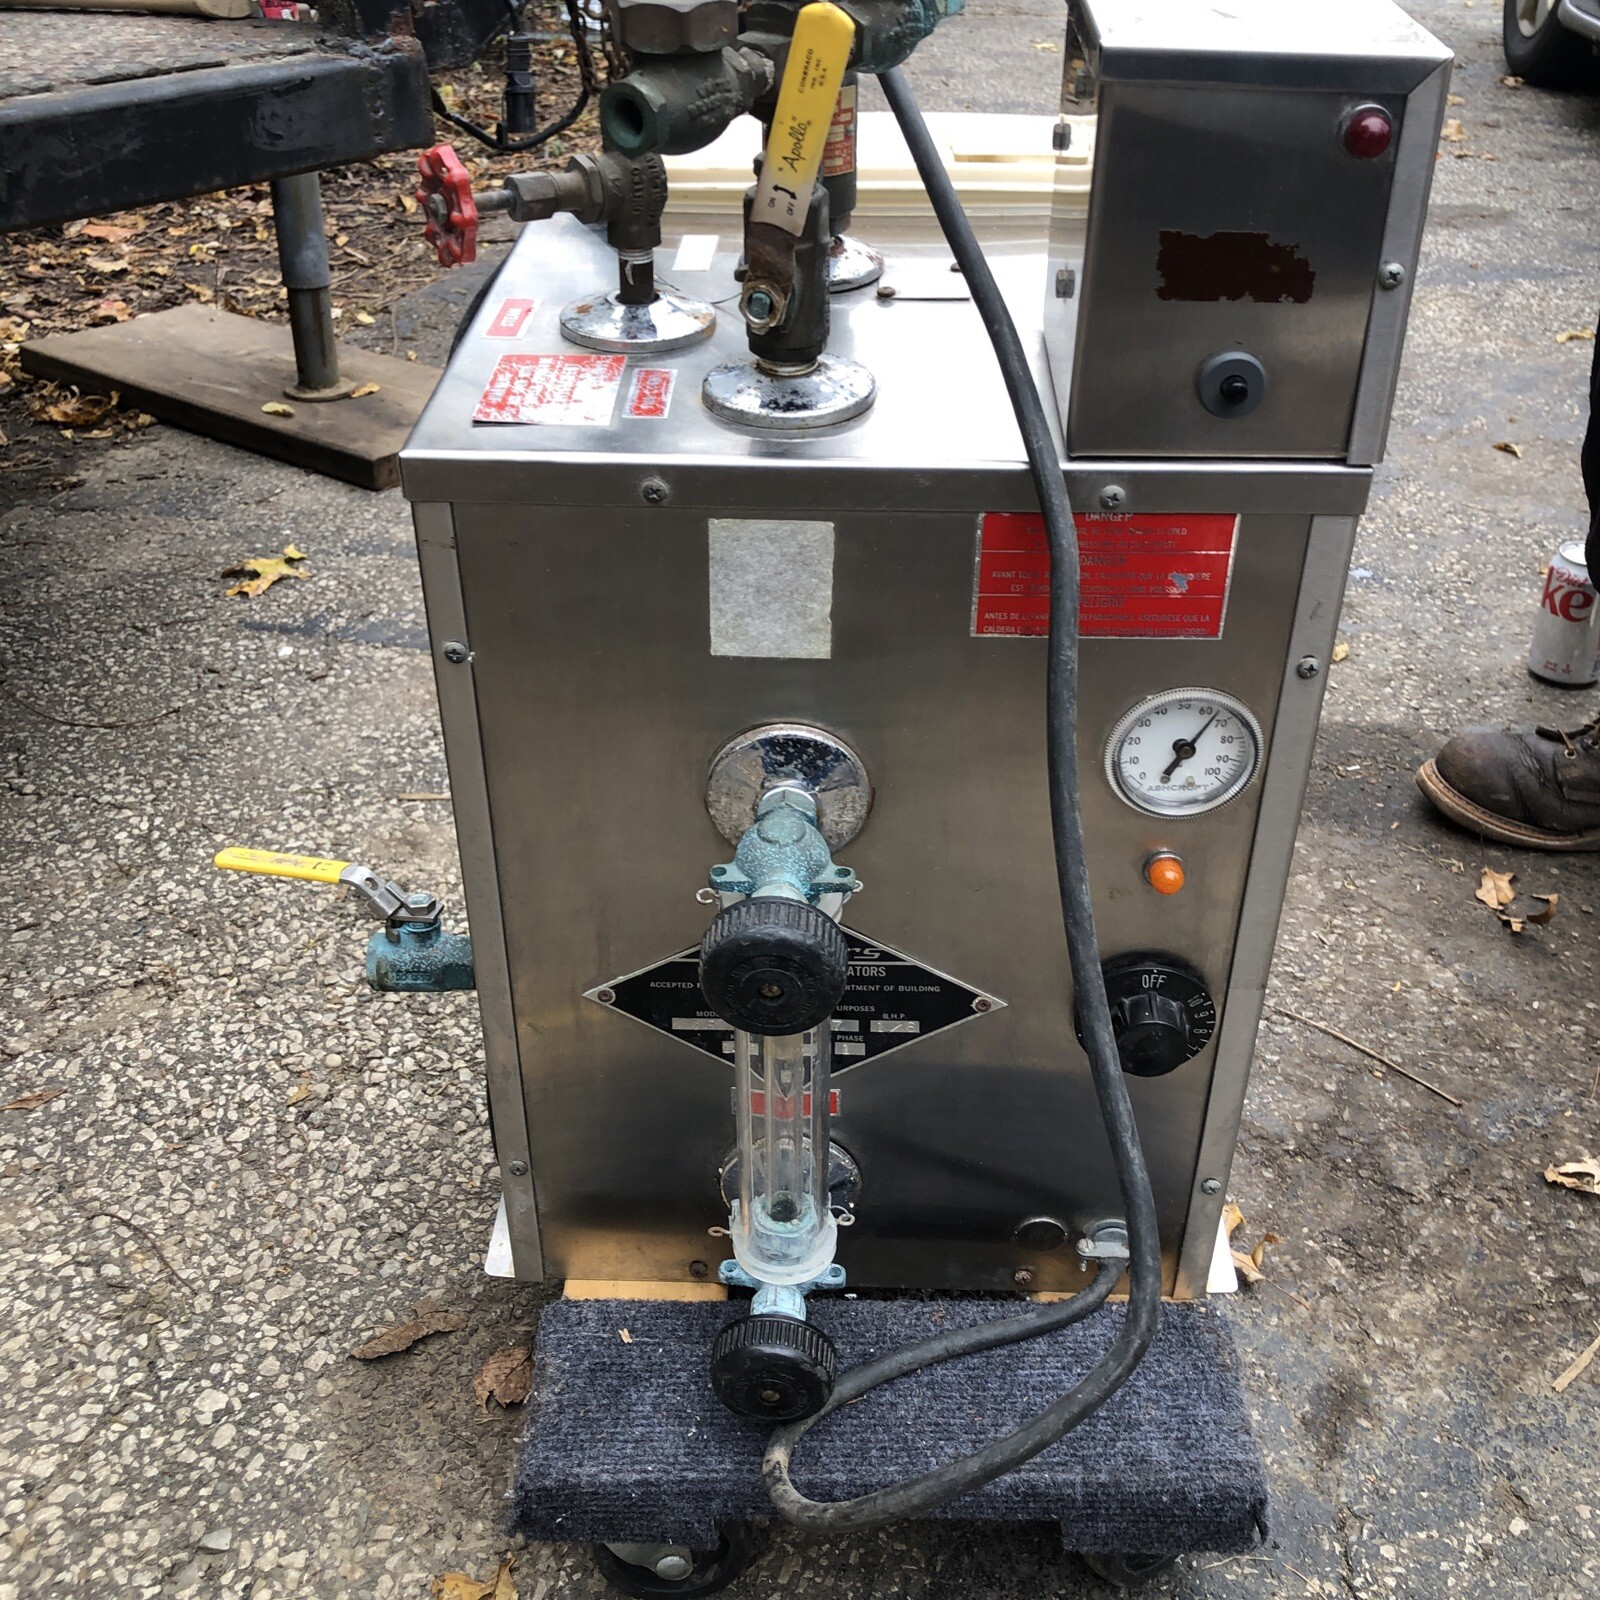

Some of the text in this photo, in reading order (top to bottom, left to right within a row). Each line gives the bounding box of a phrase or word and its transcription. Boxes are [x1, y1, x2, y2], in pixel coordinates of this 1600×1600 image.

[798, 48, 814, 94] CONBRACO
[767, 196, 776, 209] ON
[785, 202, 796, 216] OFF
[1556, 567, 1589, 588] Diet
[984, 612, 1008, 621] ANTES
[1009, 612, 1020, 620] DE
[1183, 615, 1198, 623] QUE
[1198, 706, 1214, 716] 60
[1138, 718, 1152, 728] 30
[1214, 719, 1228, 729] 70
[1127, 736, 1141, 746] 20
[1220, 735, 1234, 745] 80
[1128, 756, 1140, 766] 10
[1215, 754, 1229, 764] 90
[1139, 771, 1147, 780] 0
[1204, 767, 1221, 777] 100
[1146, 784, 1209, 792] ASHCROFT
[846, 966, 887, 978] ATORS
[649, 981, 695, 990] ACCEPTED
[1141, 974, 1168, 989] OFF
[844, 984, 880, 992] RTMENT
[898, 985, 941, 993] BUILDING
[695, 1010, 720, 1018] MOD
[836, 1005, 876, 1013] URPOSES
[836, 1034, 865, 1043] PHASE
[841, 1044, 850, 1055] 1
